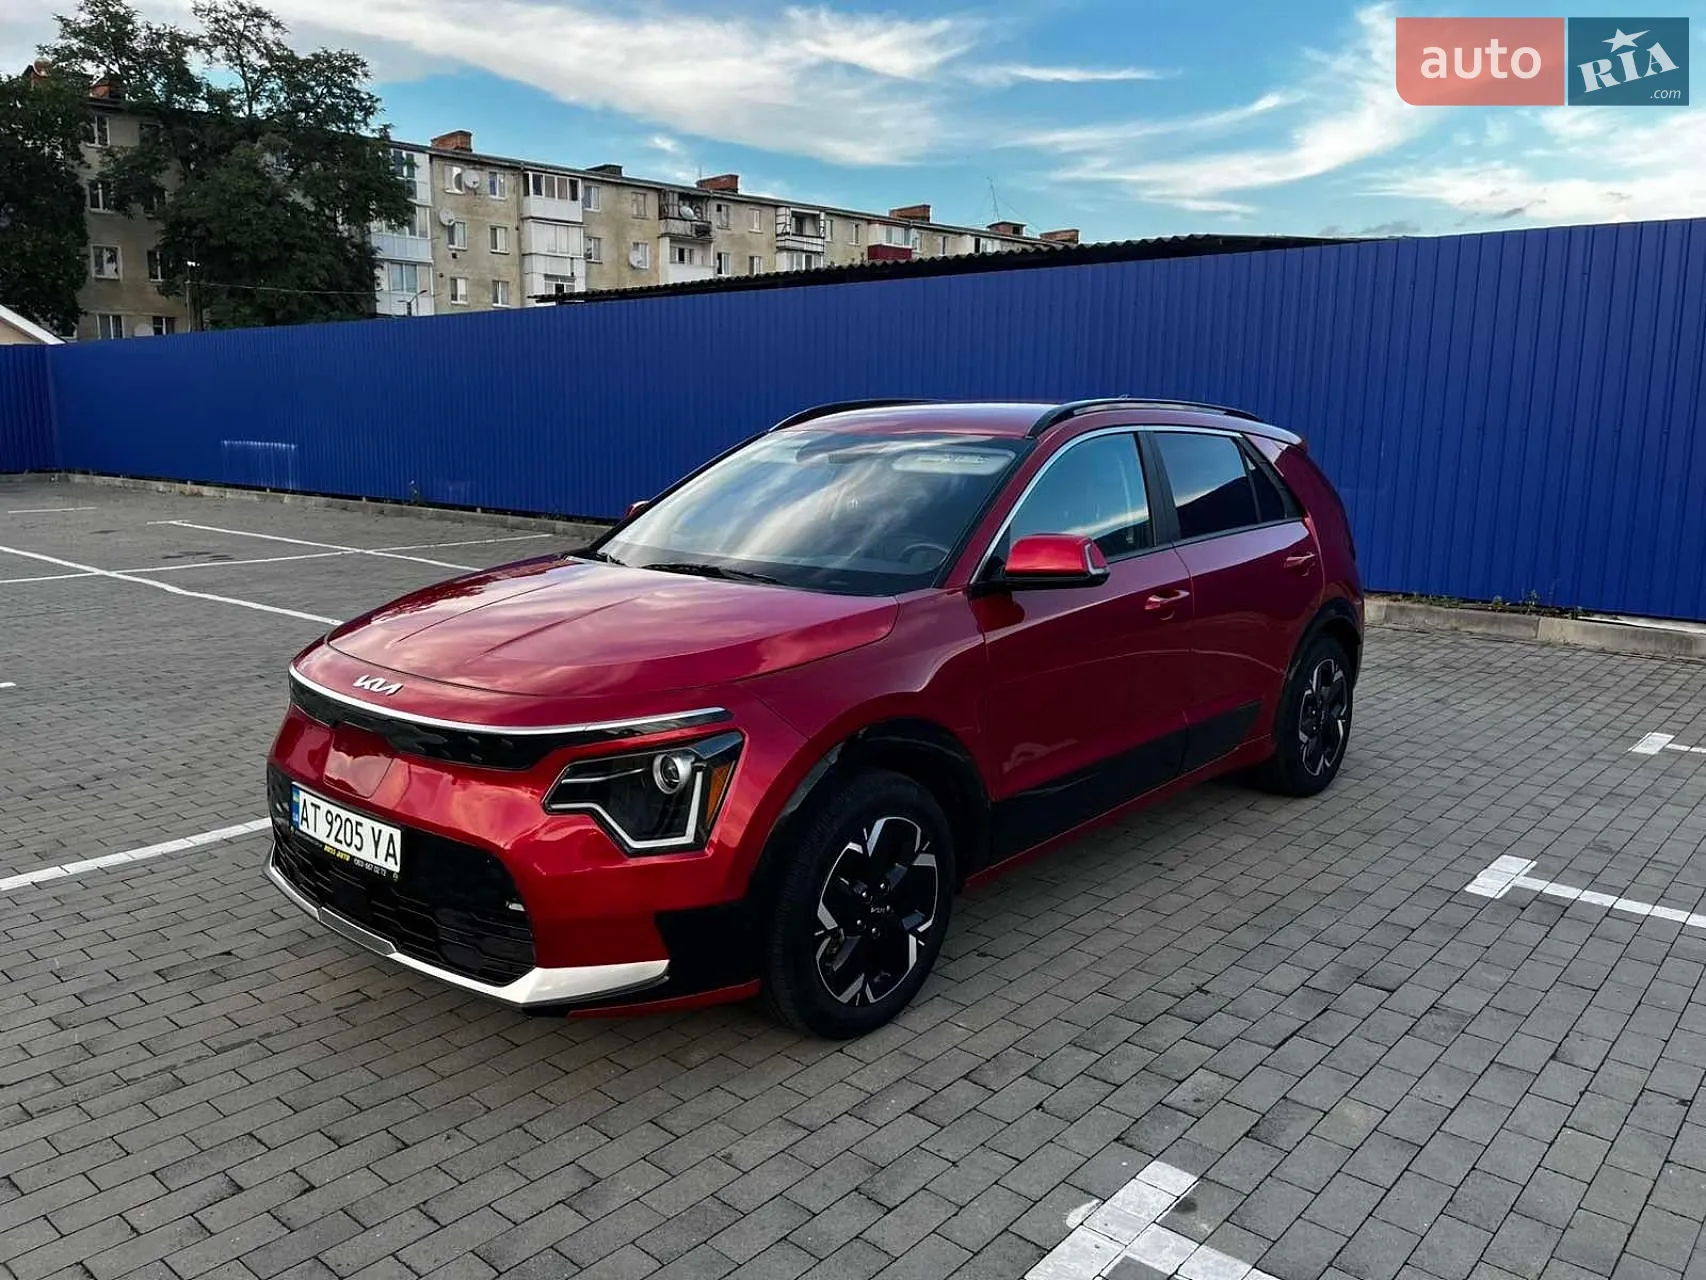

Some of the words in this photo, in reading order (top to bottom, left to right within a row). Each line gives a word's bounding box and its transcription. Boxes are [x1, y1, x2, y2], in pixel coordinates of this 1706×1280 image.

[353, 674, 404, 696] KIA
[300, 798, 321, 833] AT
[325, 810, 364, 852] 9205
[371, 826, 399, 867] YA
